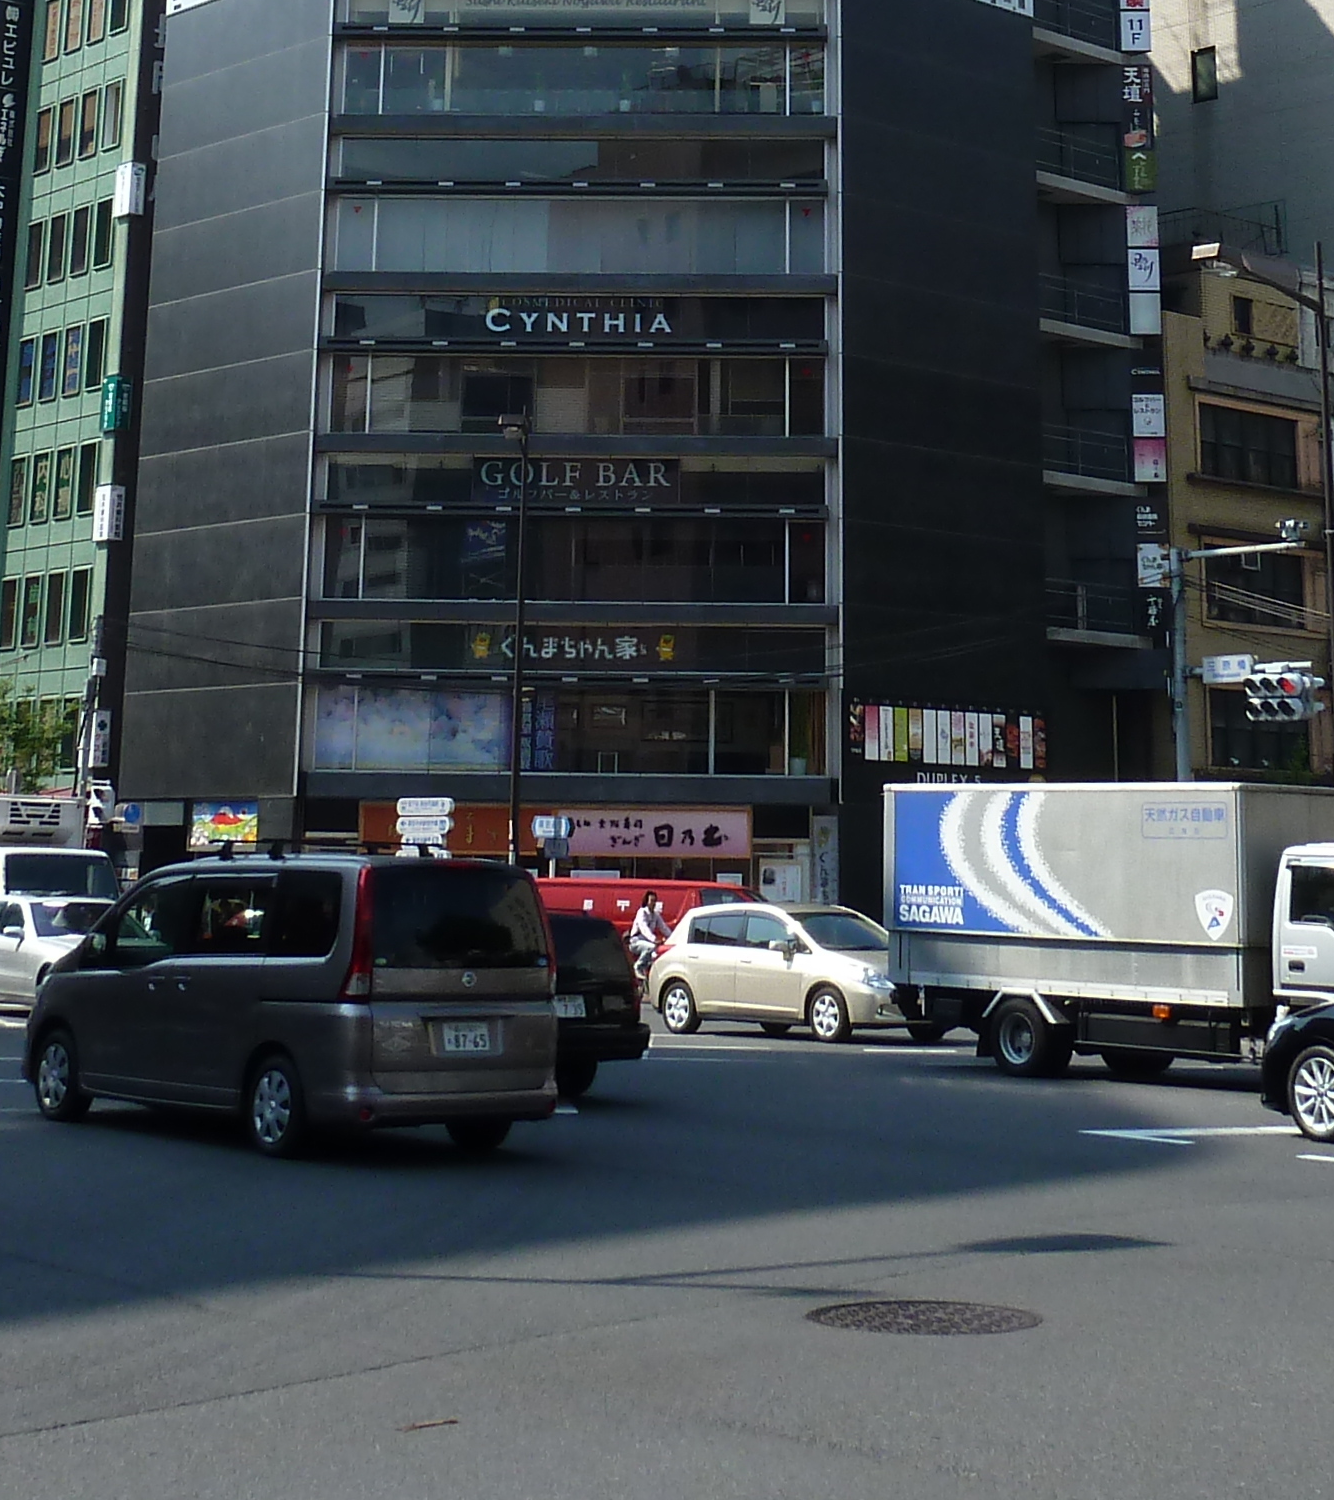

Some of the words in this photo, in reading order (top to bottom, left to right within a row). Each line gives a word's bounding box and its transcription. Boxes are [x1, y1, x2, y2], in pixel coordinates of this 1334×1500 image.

[485, 308, 673, 333] CYNTHIA
[480, 461, 582, 487] GOLF
[595, 462, 672, 487] BAR
[1144, 807, 1226, 822] 天然ガス自動車
[898, 904, 965, 926] SAGAWA
